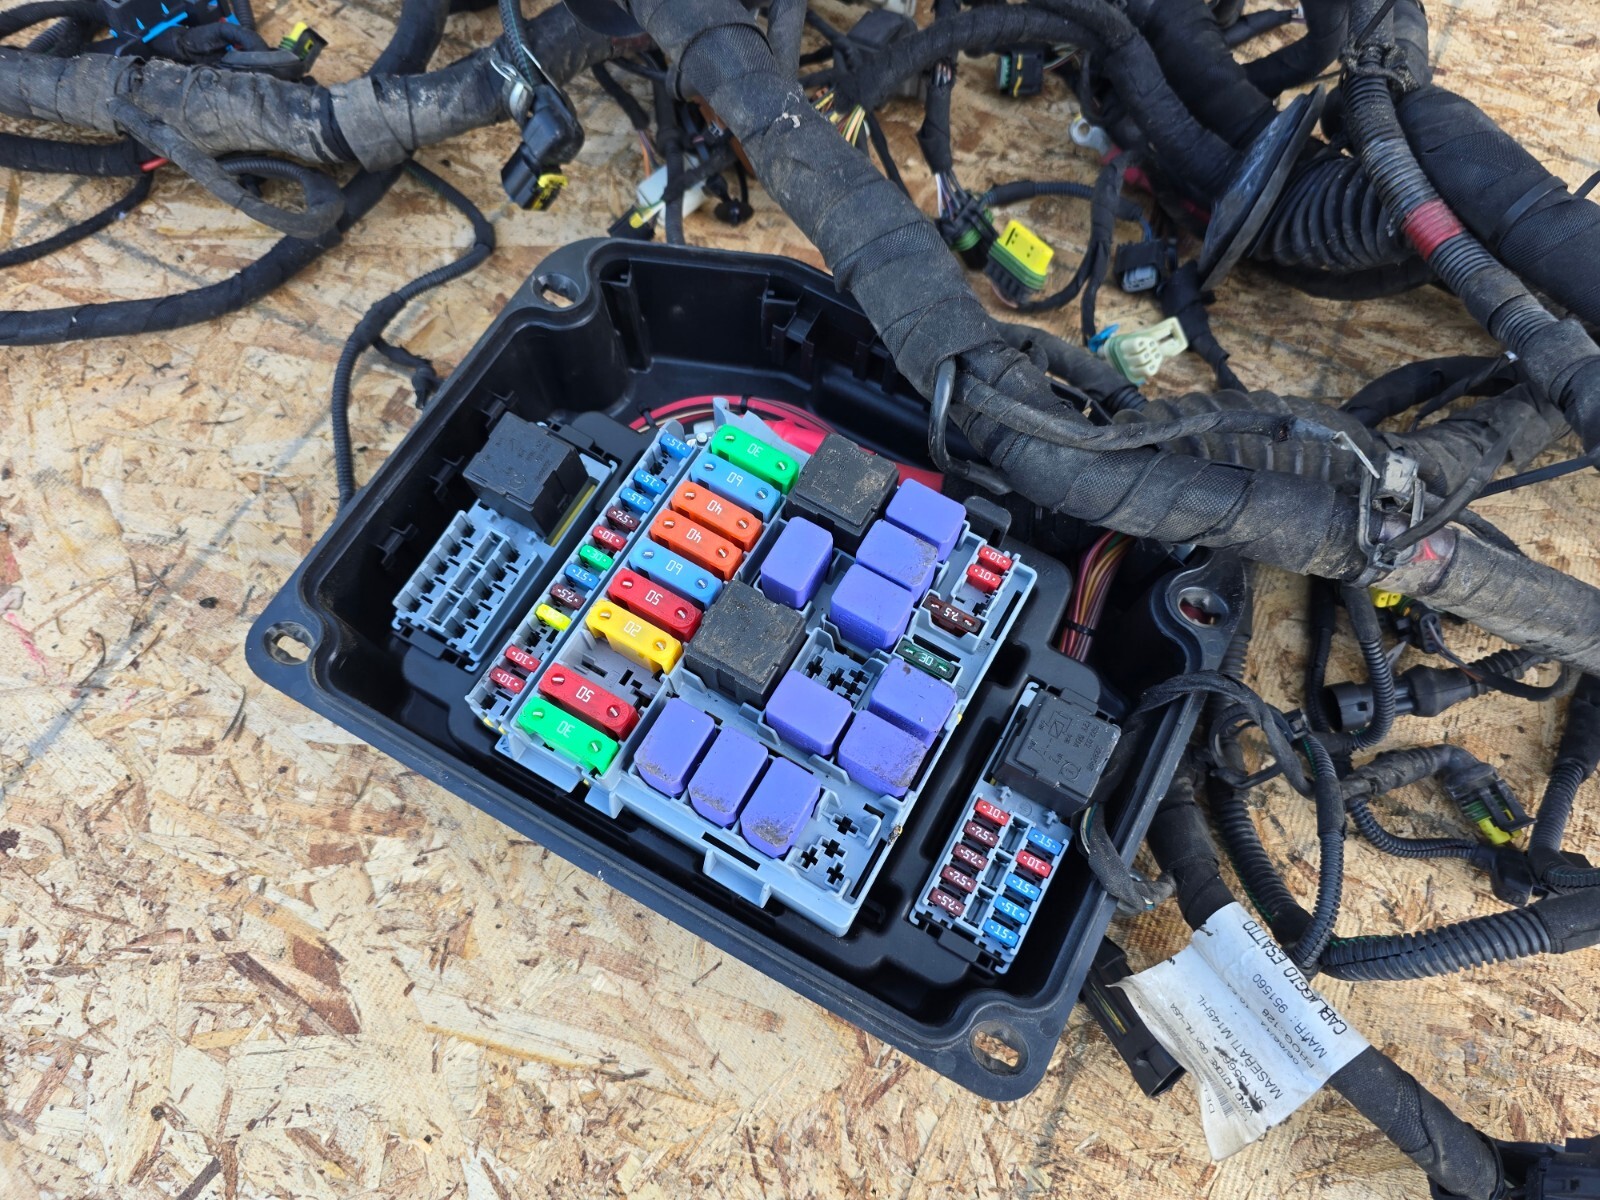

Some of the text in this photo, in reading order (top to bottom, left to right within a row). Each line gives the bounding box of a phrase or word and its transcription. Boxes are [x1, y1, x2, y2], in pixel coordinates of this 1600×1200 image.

[669, 438, 683, 451] 15
[747, 443, 764, 457] 30
[643, 474, 656, 487] 15
[726, 471, 744, 488] 60
[629, 492, 642, 504] 15
[706, 499, 723, 515] 40
[616, 510, 630, 524] 7.5
[601, 530, 615, 542] 10
[686, 527, 702, 543] 40
[989, 551, 1003, 564] 10
[577, 569, 590, 581] 15
[665, 559, 684, 576] 60
[979, 569, 991, 580] 10
[560, 589, 574, 602] 7.5
[645, 589, 663, 606] 50
[943, 606, 959, 622] 7.5
[623, 620, 642, 638] 20
[515, 652, 530, 664] 10
[918, 652, 934, 666] 30
[500, 673, 514, 686] 10
[575, 685, 595, 703] 50
[556, 720, 575, 737] 30
[987, 805, 1001, 818] 10
[975, 826, 989, 841] 7.5
[1039, 834, 1052, 847] 15
[964, 849, 978, 864] 7.5
[1026, 855, 1041, 869] 10
[953, 870, 967, 886] 7.5
[1017, 879, 1030, 893] 15
[941, 894, 956, 910] 7.5
[1004, 902, 1019, 916] 15
[994, 924, 1008, 939] 15
[1242, 920, 1348, 1036] CABLAGGIO ESATTO
[1252, 973, 1289, 1014] 951560
[1197, 994, 1234, 1040] M145HL
[1208, 1056, 1236, 1091] MOTORE
[1230, 1039, 1284, 1100] MASERATI
[1235, 1092, 1254, 1116] VANO
